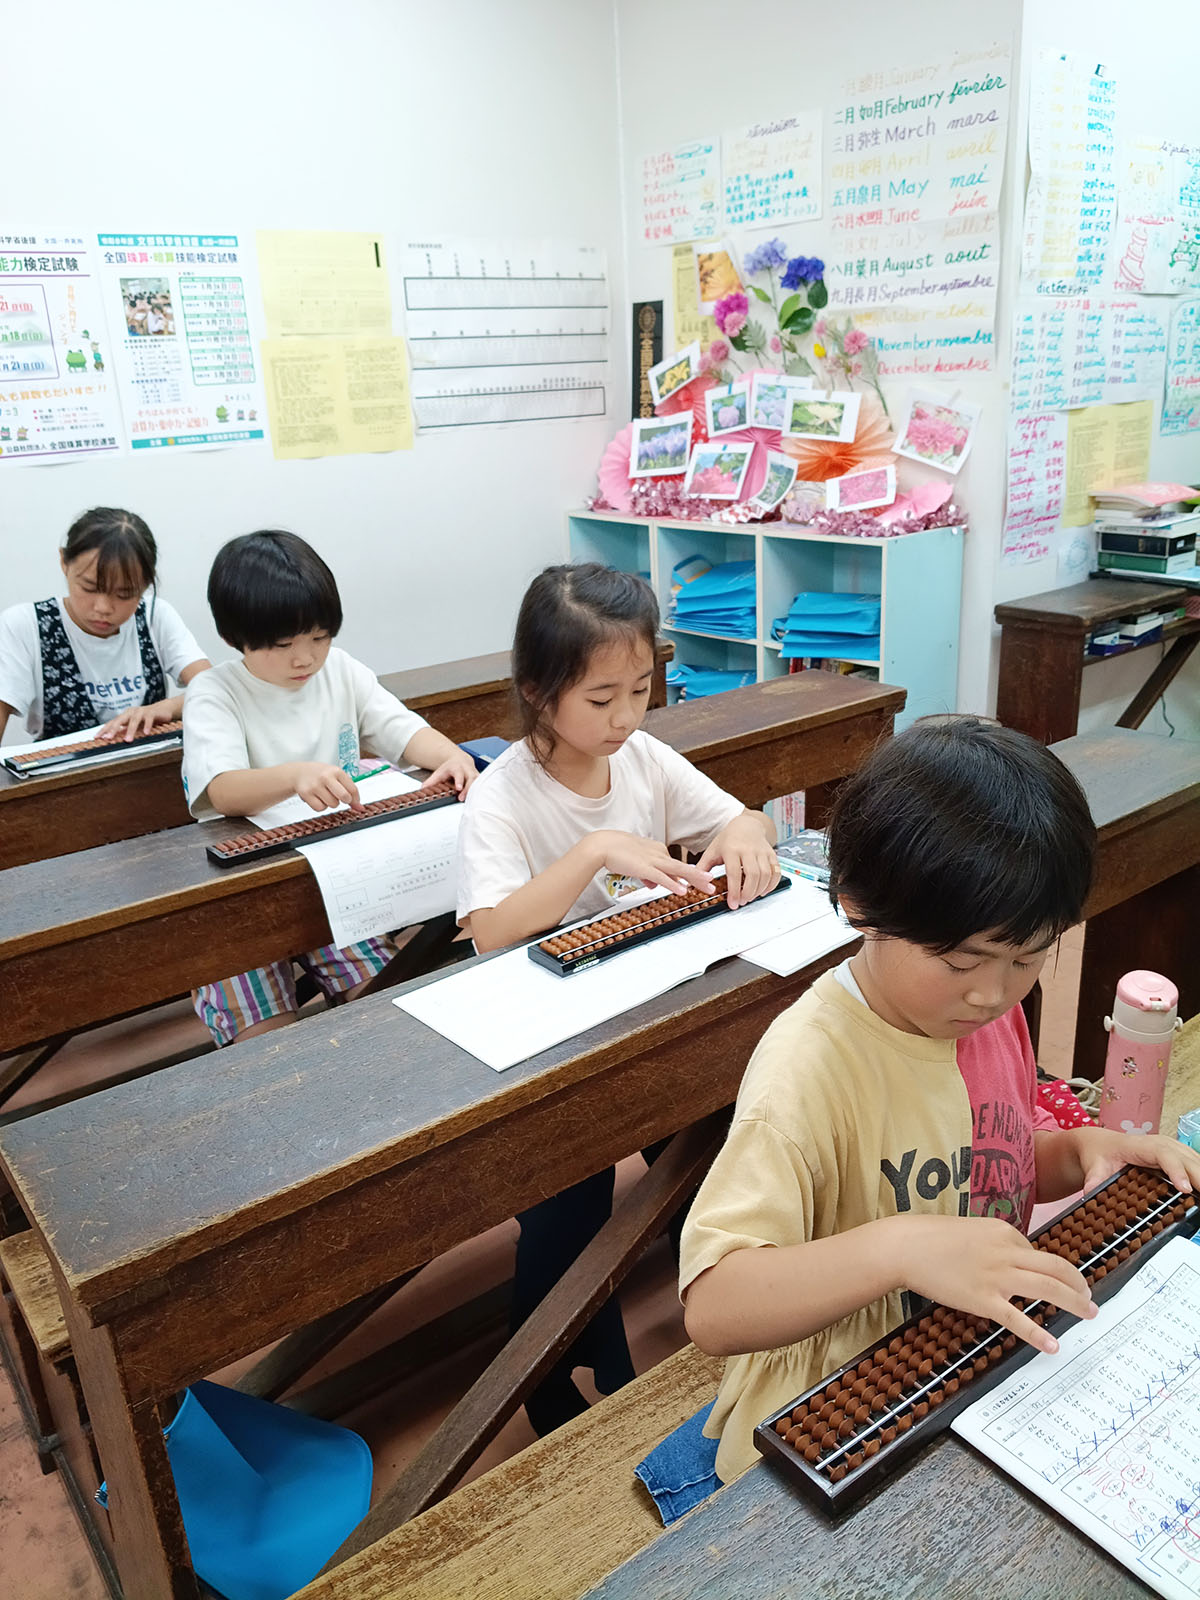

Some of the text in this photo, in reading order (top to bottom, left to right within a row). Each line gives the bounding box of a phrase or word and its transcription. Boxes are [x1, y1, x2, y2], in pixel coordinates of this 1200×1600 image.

[885, 90, 944, 116] February
[884, 116, 935, 144] March
[889, 178, 929, 199] May
[950, 163, 990, 188] mai
[882, 254, 934, 277] August
[1036, 280, 1067, 294] dictée
